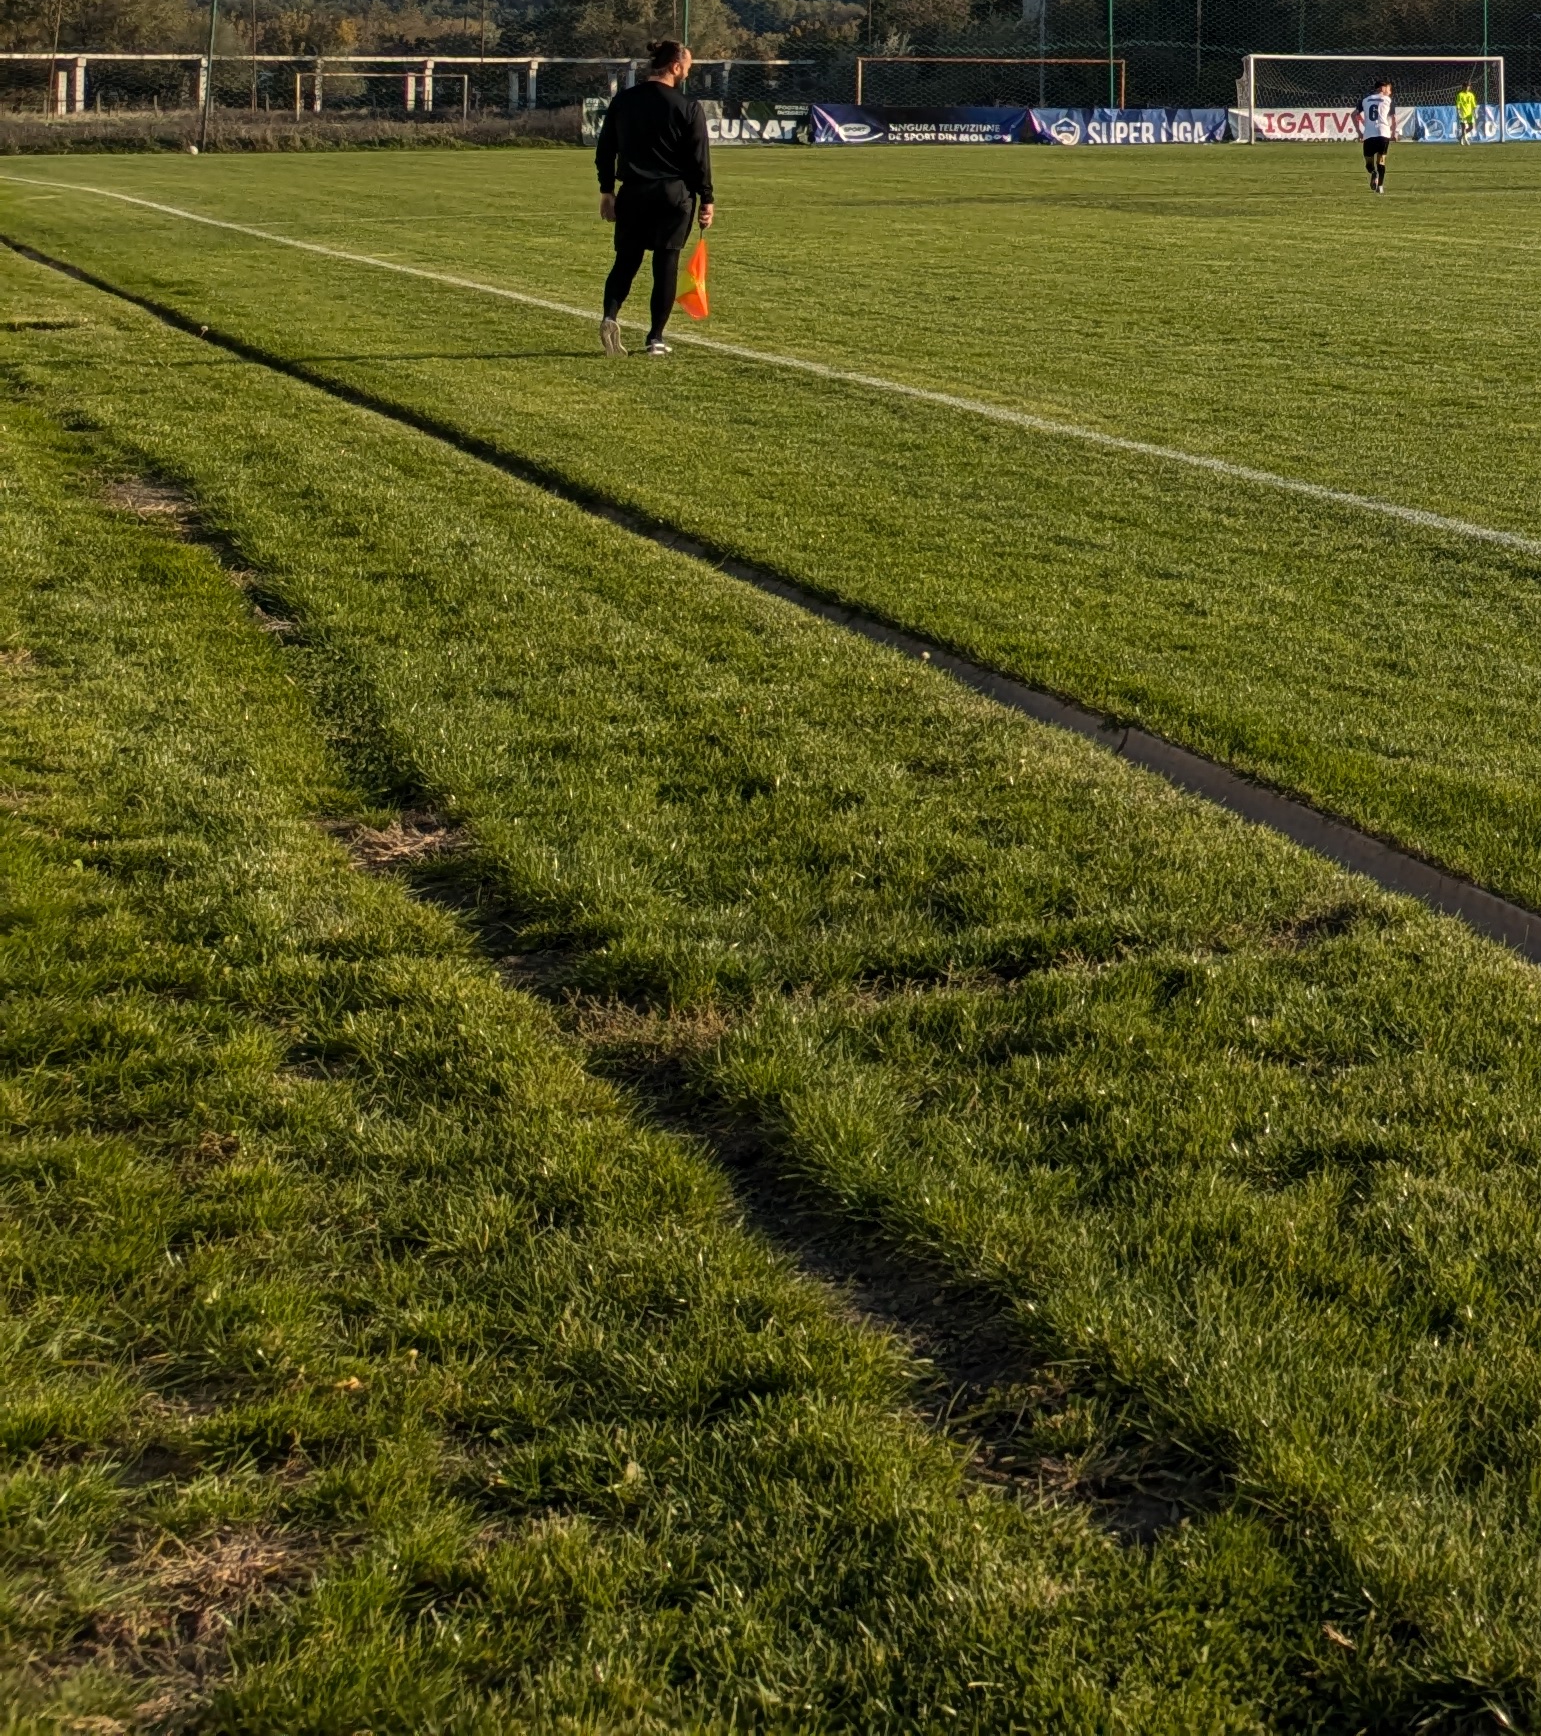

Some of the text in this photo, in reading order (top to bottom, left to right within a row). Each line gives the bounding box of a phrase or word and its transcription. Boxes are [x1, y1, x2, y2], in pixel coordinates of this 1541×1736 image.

[1368, 104, 1379, 121] 6
[706, 119, 797, 140] CURAT
[888, 123, 1001, 133] SINGURA TELEVIZIUNE
[888, 132, 902, 141] DE
[904, 132, 936, 141] SPORT
[938, 132, 957, 141] DIN
[1088, 122, 1155, 144] SUPER
